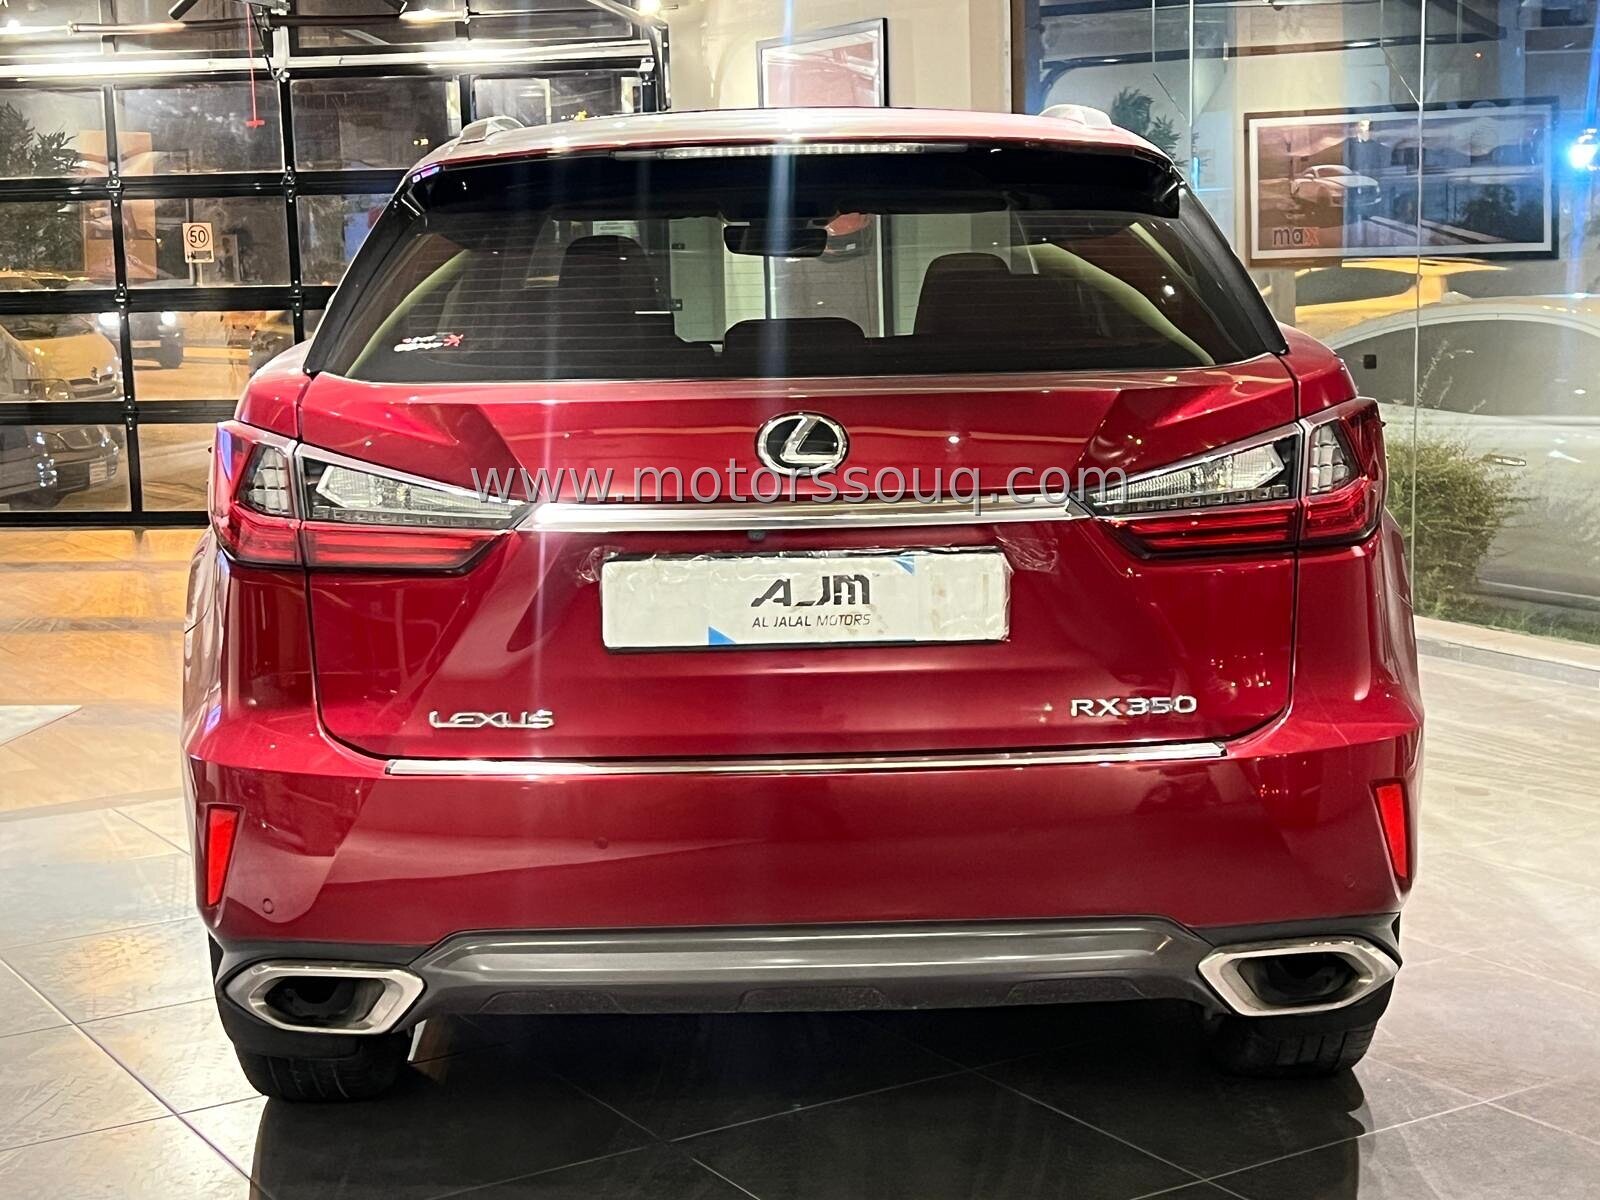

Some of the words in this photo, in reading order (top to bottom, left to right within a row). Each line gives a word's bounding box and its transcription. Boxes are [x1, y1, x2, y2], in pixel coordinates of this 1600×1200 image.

[190, 229, 206, 243] 50
[1273, 228, 1319, 246] max
[752, 617, 769, 627] AL
[773, 616, 812, 627] JALAL
[816, 614, 871, 626] MOTORS
[429, 710, 554, 728] LEXUS
